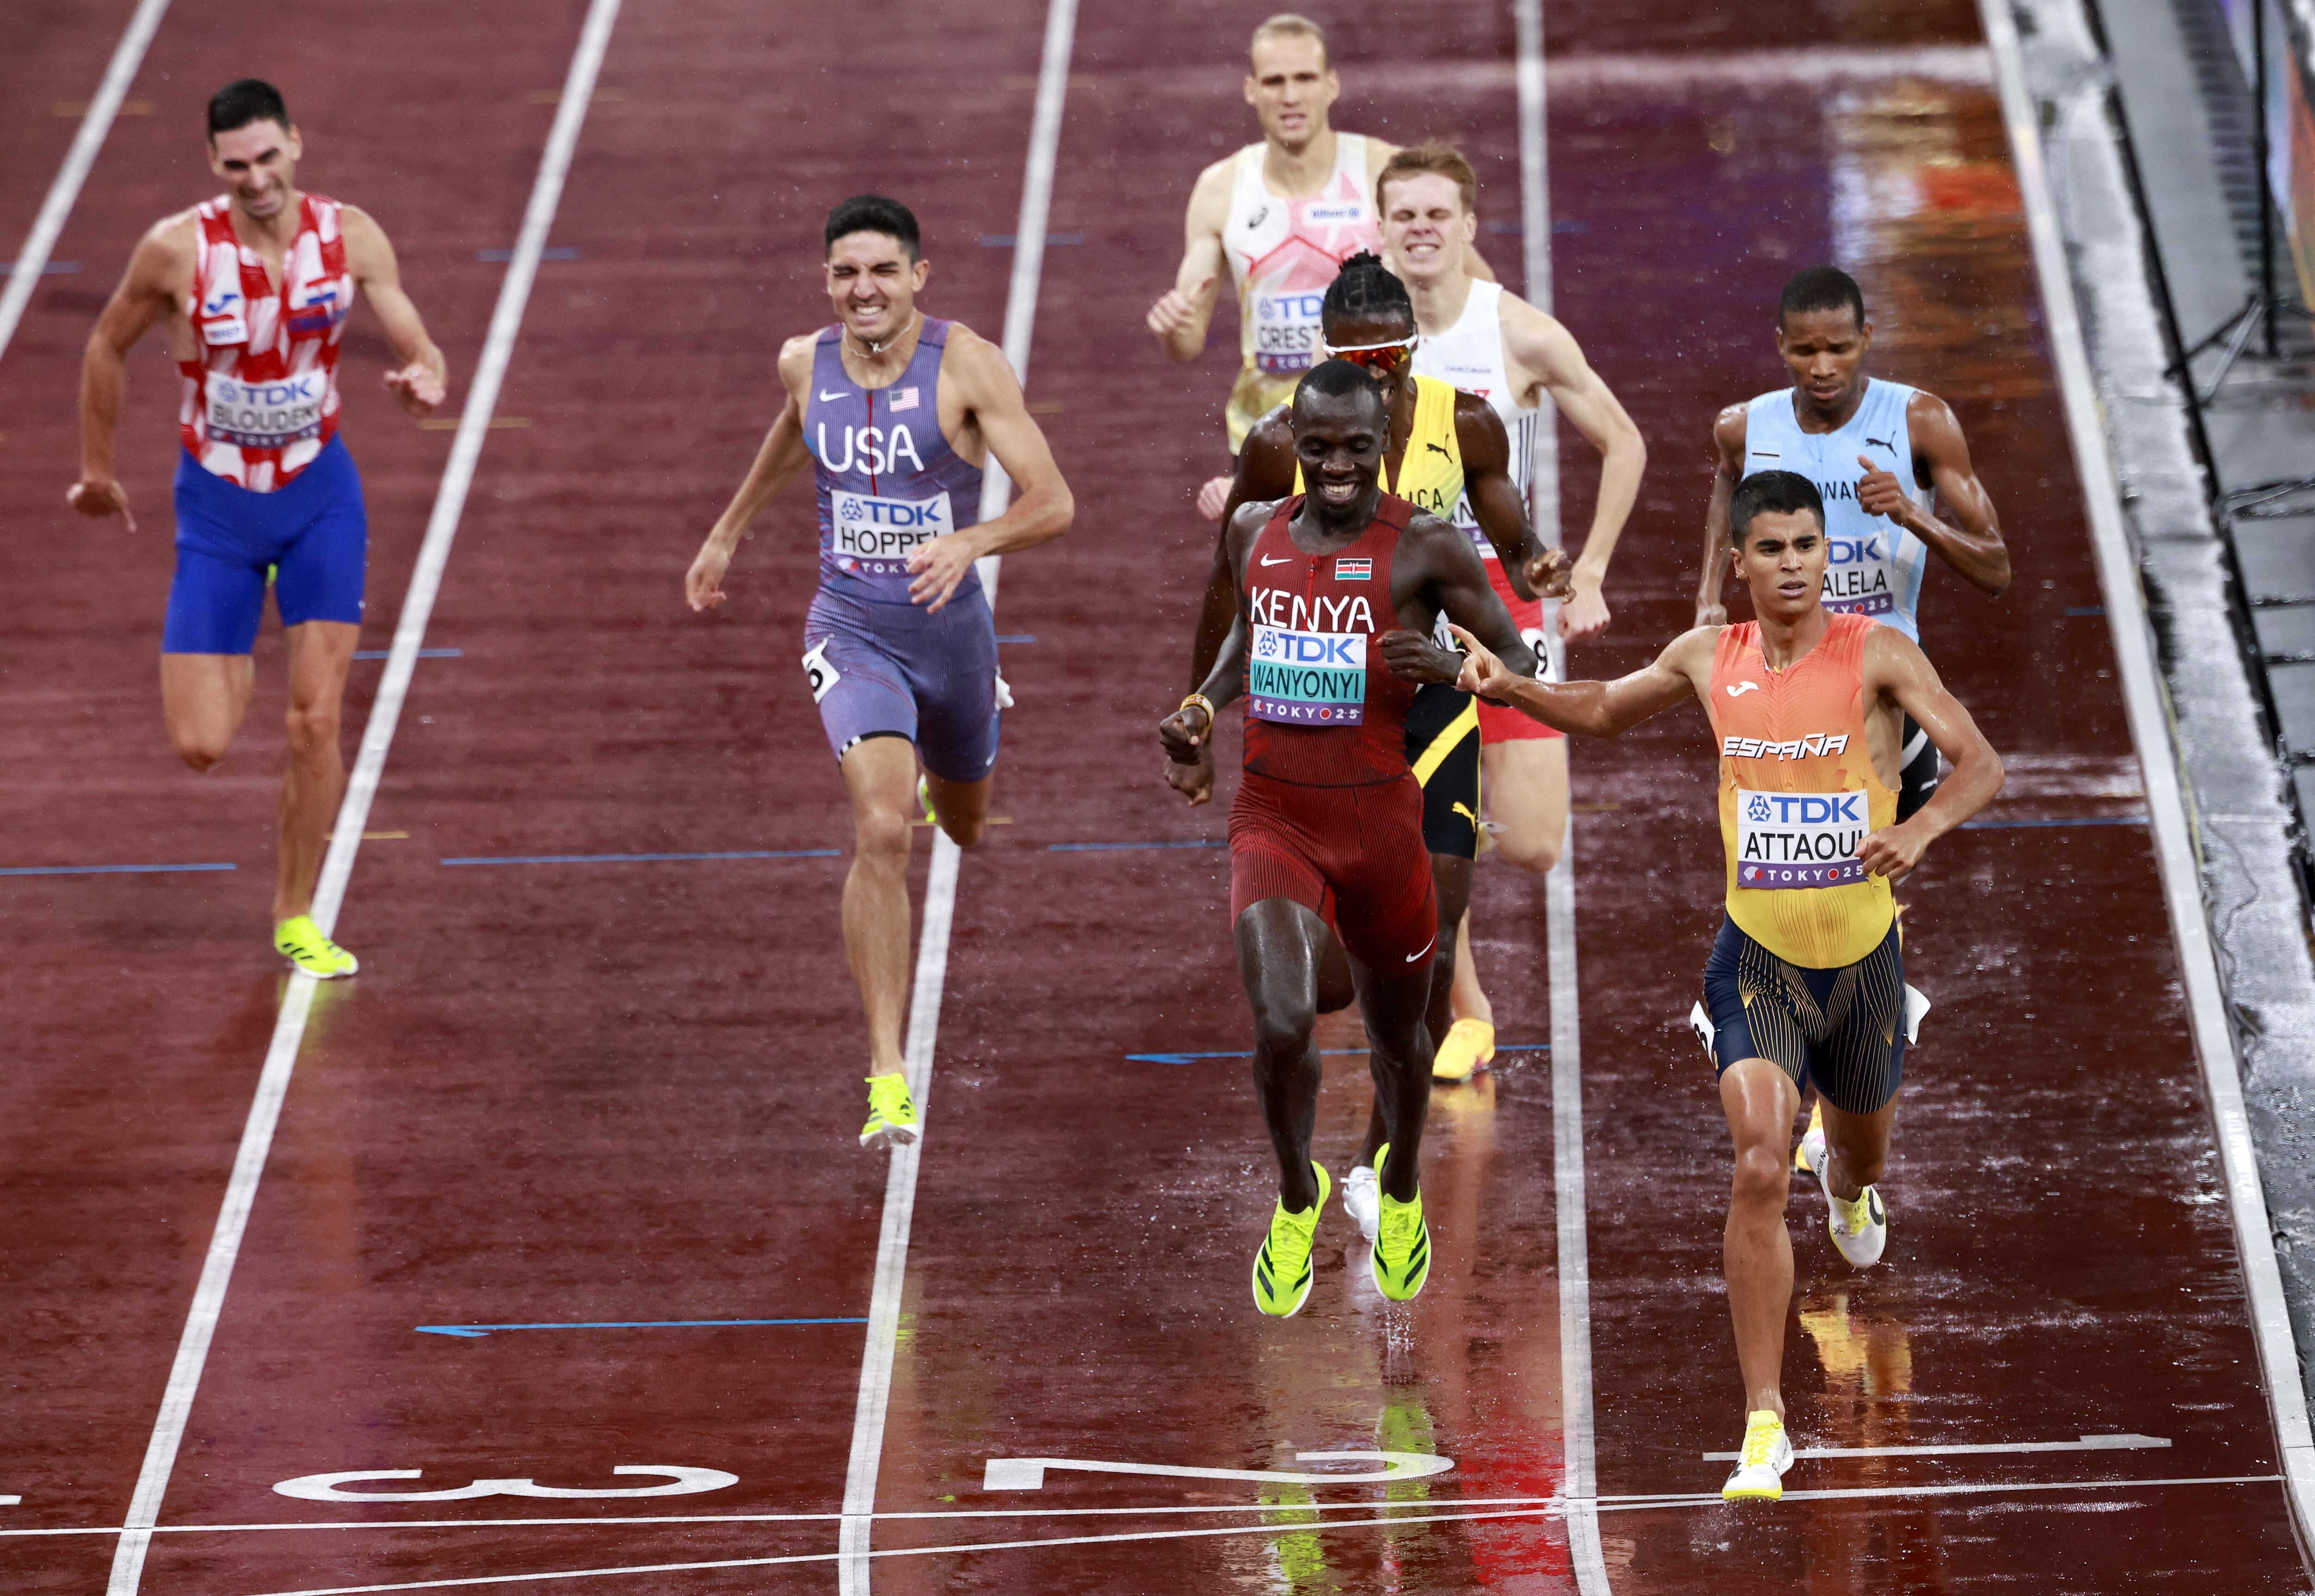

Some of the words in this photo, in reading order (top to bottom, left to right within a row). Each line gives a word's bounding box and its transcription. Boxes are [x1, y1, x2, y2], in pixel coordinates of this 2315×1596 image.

[240, 378, 314, 405] TDK
[818, 422, 925, 476] USA
[863, 501, 942, 526] TDK
[841, 526, 939, 554] HOPPE
[1251, 586, 1375, 633] KENYA
[1278, 633, 1356, 664] TDK
[1533, 639, 1547, 675] 9
[1253, 664, 1359, 699] WANYONYI
[1722, 733, 1850, 762] ESPAÑA
[1771, 795, 1860, 824] TDK
[272, 1466, 739, 1502] 3
[983, 1451, 1455, 1490] 2
